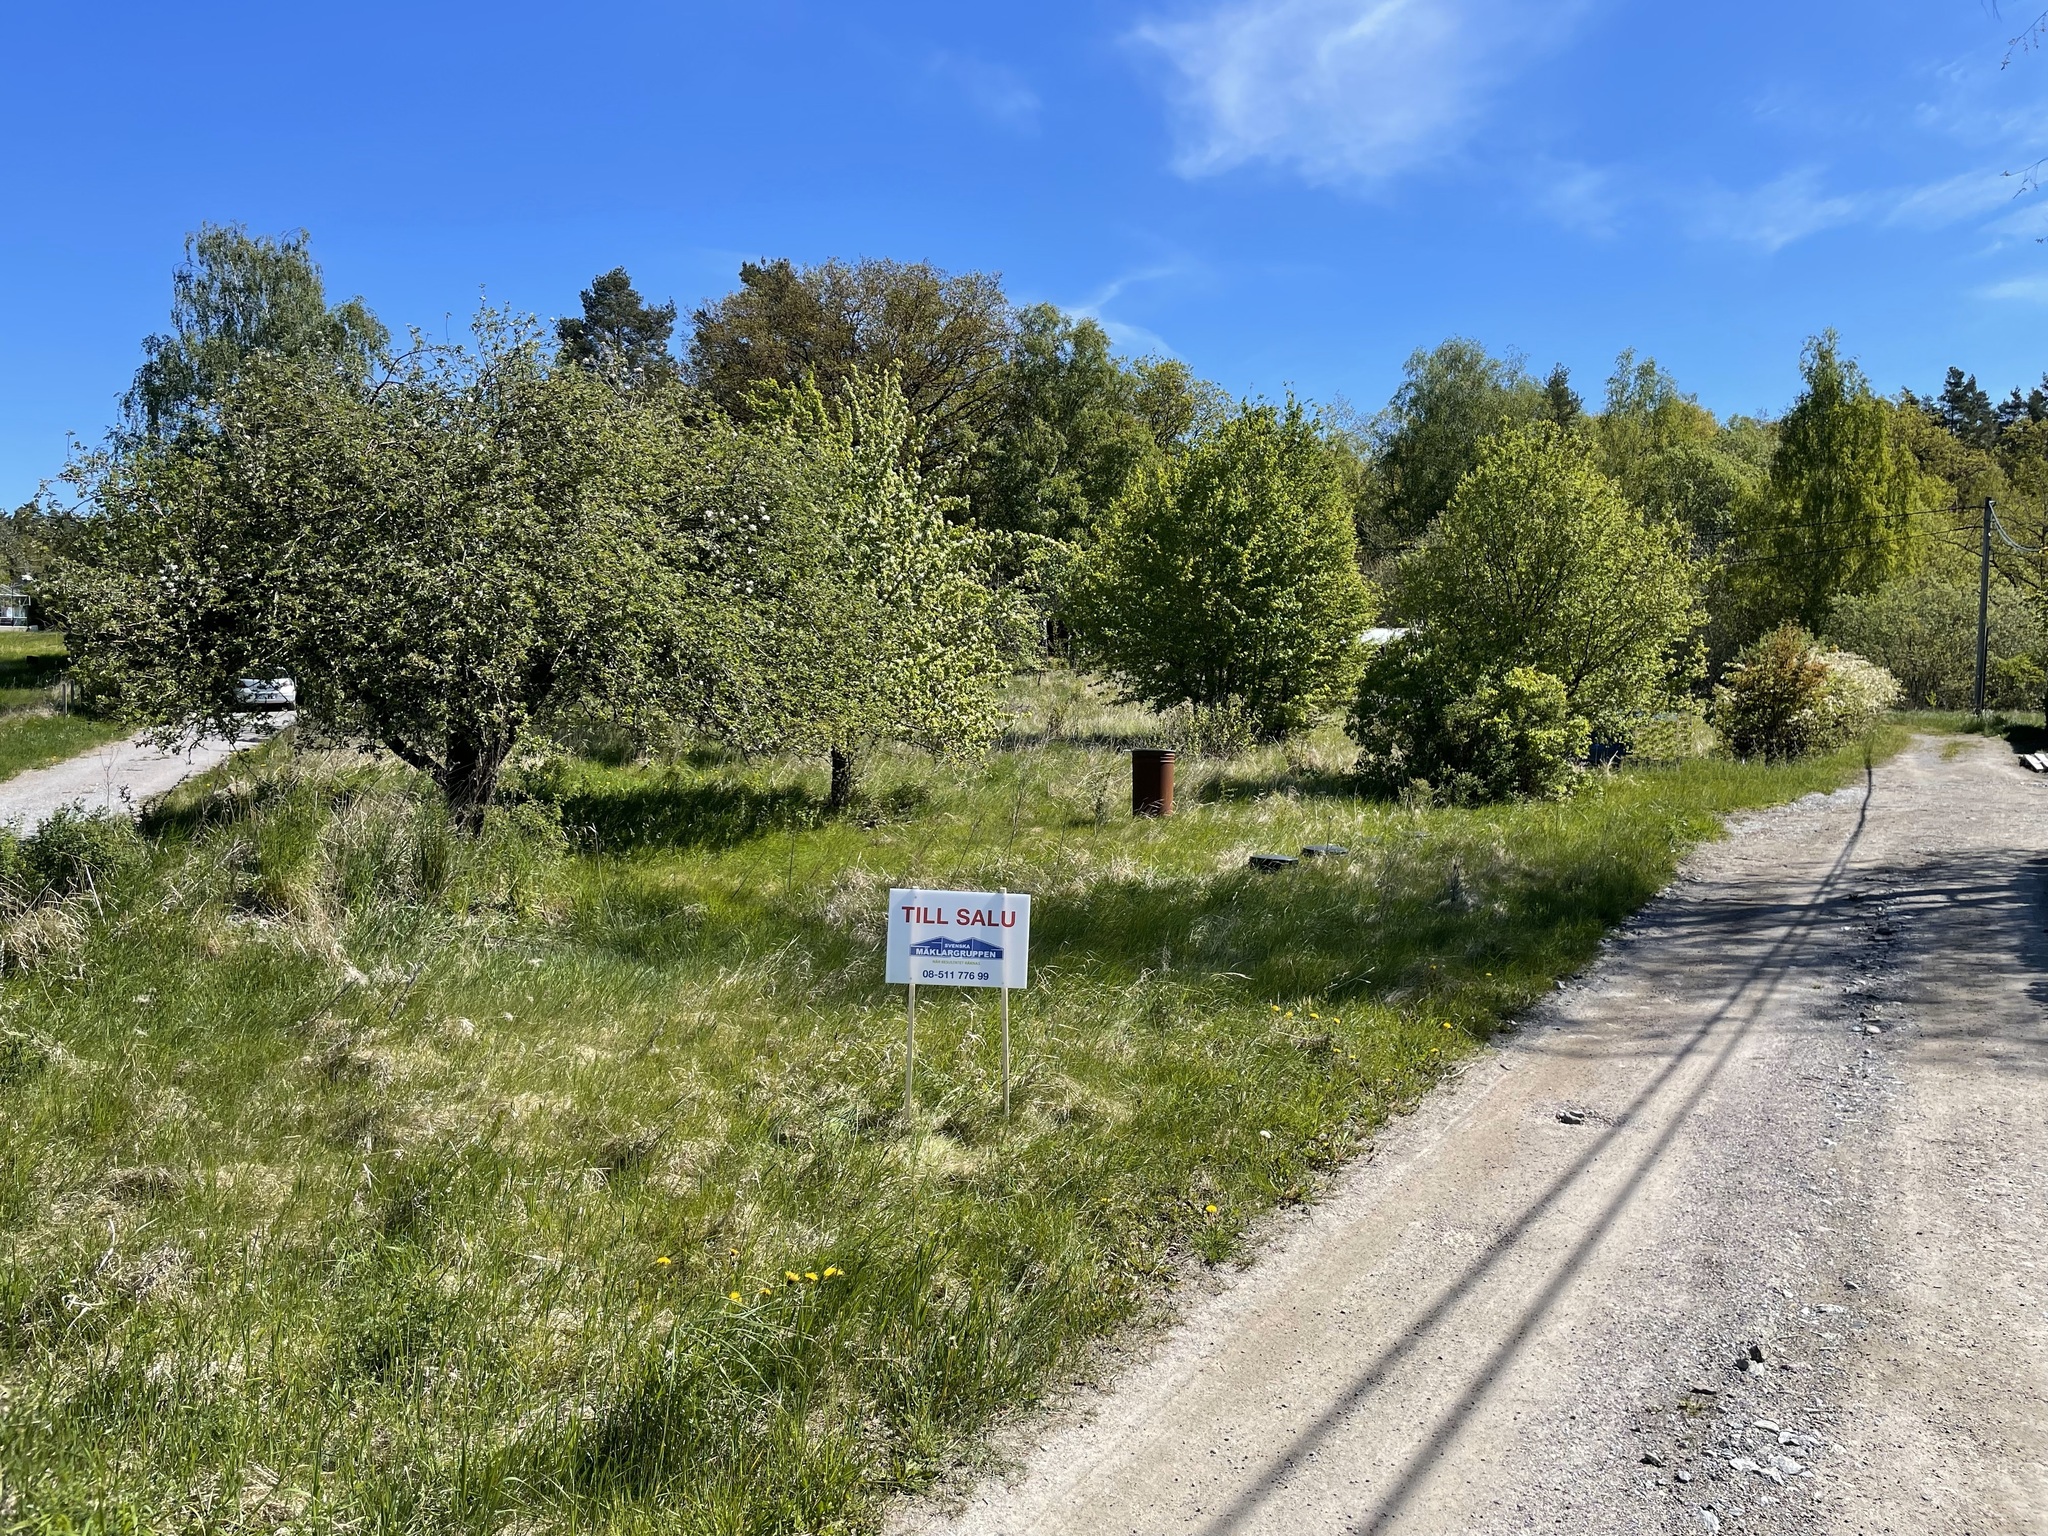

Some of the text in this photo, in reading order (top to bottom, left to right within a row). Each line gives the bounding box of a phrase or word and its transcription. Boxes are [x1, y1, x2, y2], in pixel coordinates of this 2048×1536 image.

[901, 906, 1016, 928] TILL SALU
[922, 969, 989, 981] 08-511 776 99
